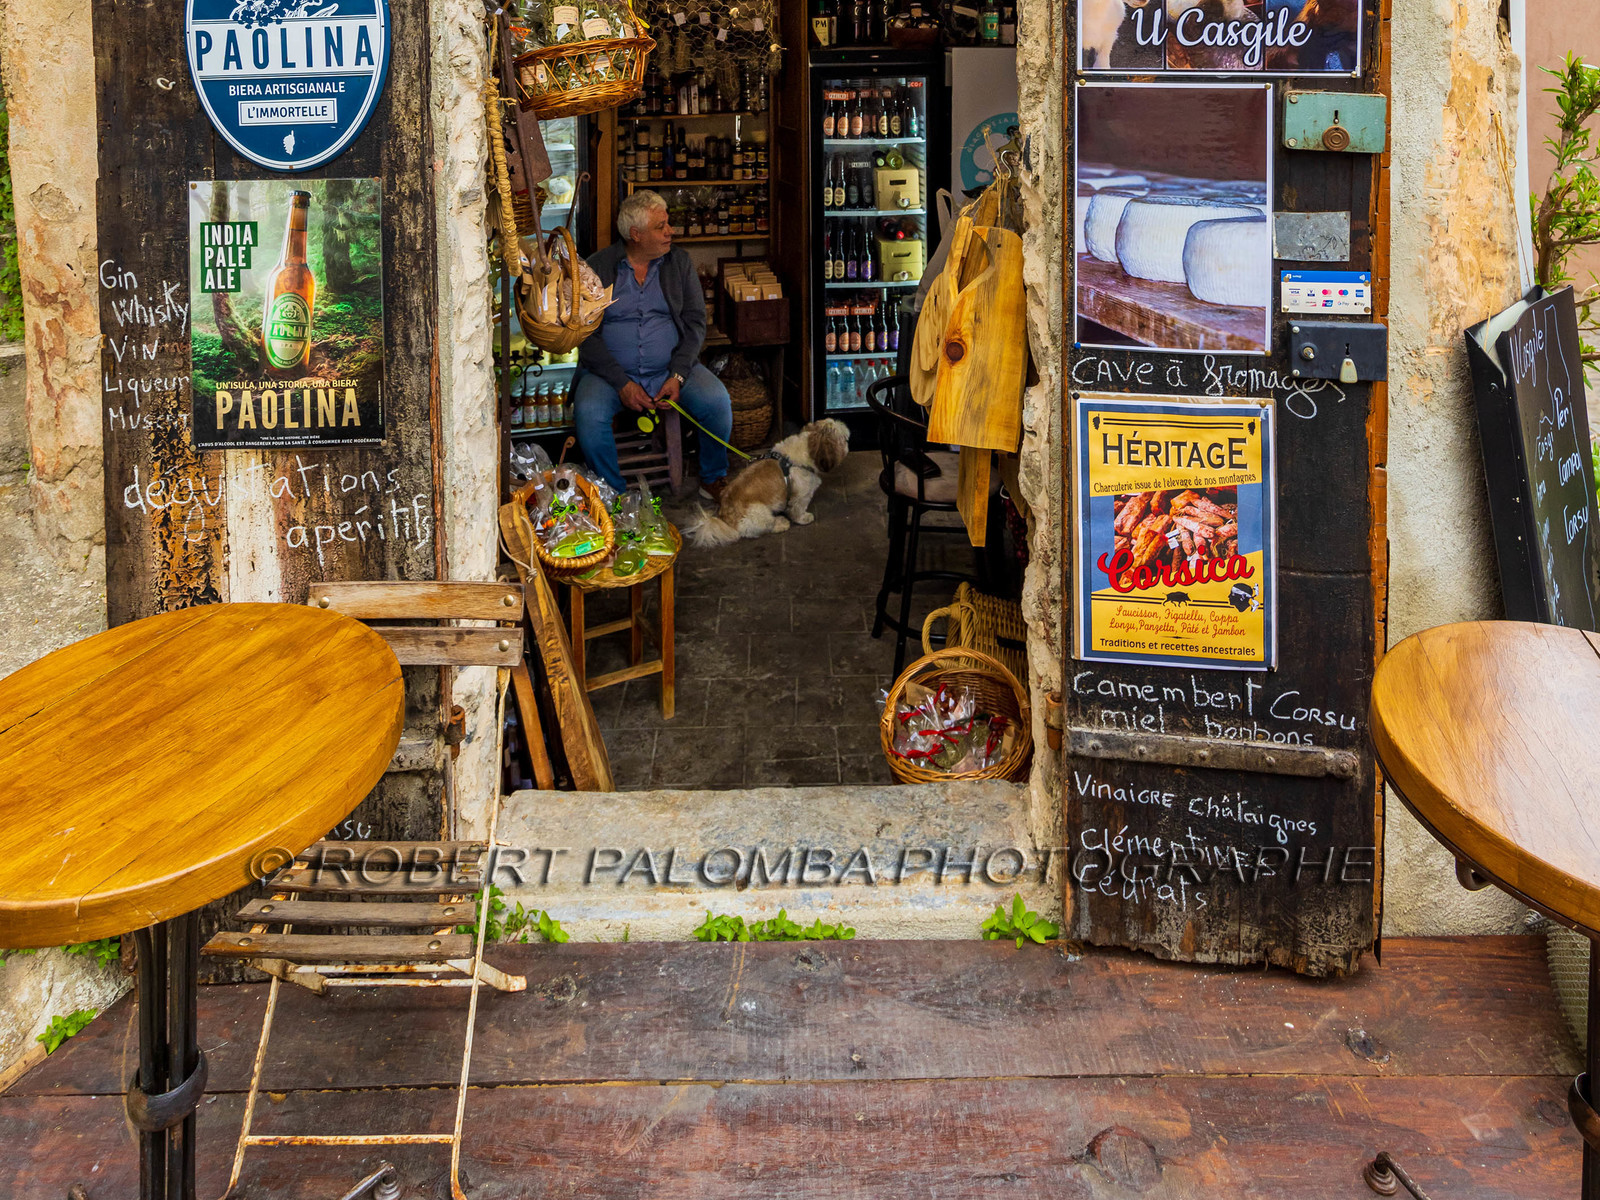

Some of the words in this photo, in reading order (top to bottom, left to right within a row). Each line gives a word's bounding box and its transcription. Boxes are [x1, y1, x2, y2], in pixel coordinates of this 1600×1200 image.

[1131, 7, 1168, 46] U
[1176, 6, 1312, 66] Casgile
[195, 25, 375, 71] PAOLINA
[229, 84, 262, 96] BIERA
[265, 82, 346, 95] ARTISGIANALE
[247, 106, 328, 119] L'IMMORTELLE
[204, 224, 253, 246] INDIA
[204, 246, 246, 268] PALE
[100, 259, 138, 291] Gin
[204, 268, 236, 290] ALE
[105, 372, 189, 408] Liqueur
[259, 381, 277, 389] UNA
[215, 388, 361, 430] PAOLINA
[1102, 431, 1248, 470] HÉRITAGE
[1093, 482, 1133, 493] Charcuterie
[1134, 480, 1151, 490] issue
[1153, 478, 1162, 489] de
[1193, 476, 1202, 486] de
[1204, 476, 1216, 485] nos
[1218, 473, 1257, 485] montagnes
[1097, 545, 1255, 593] Corsica
[1115, 605, 1162, 621] Saucisson,
[1164, 608, 1206, 624] Figatellu,
[1209, 610, 1239, 626] Coppa
[1109, 618, 1138, 633] Lonzu,
[1138, 619, 1178, 635] Panzetta,
[1181, 622, 1200, 634] Pâté
[1201, 625, 1210, 634] et
[1212, 623, 1246, 638] Jambon
[1100, 638, 1146, 649] Traditions
[1148, 641, 1158, 649] et
[1160, 642, 1199, 652] recettes
[1202, 645, 1256, 656] ancestrales
[1073, 670, 1262, 716] Camembert
[1101, 703, 1165, 733] miel
[1205, 714, 1313, 746] bonbons
